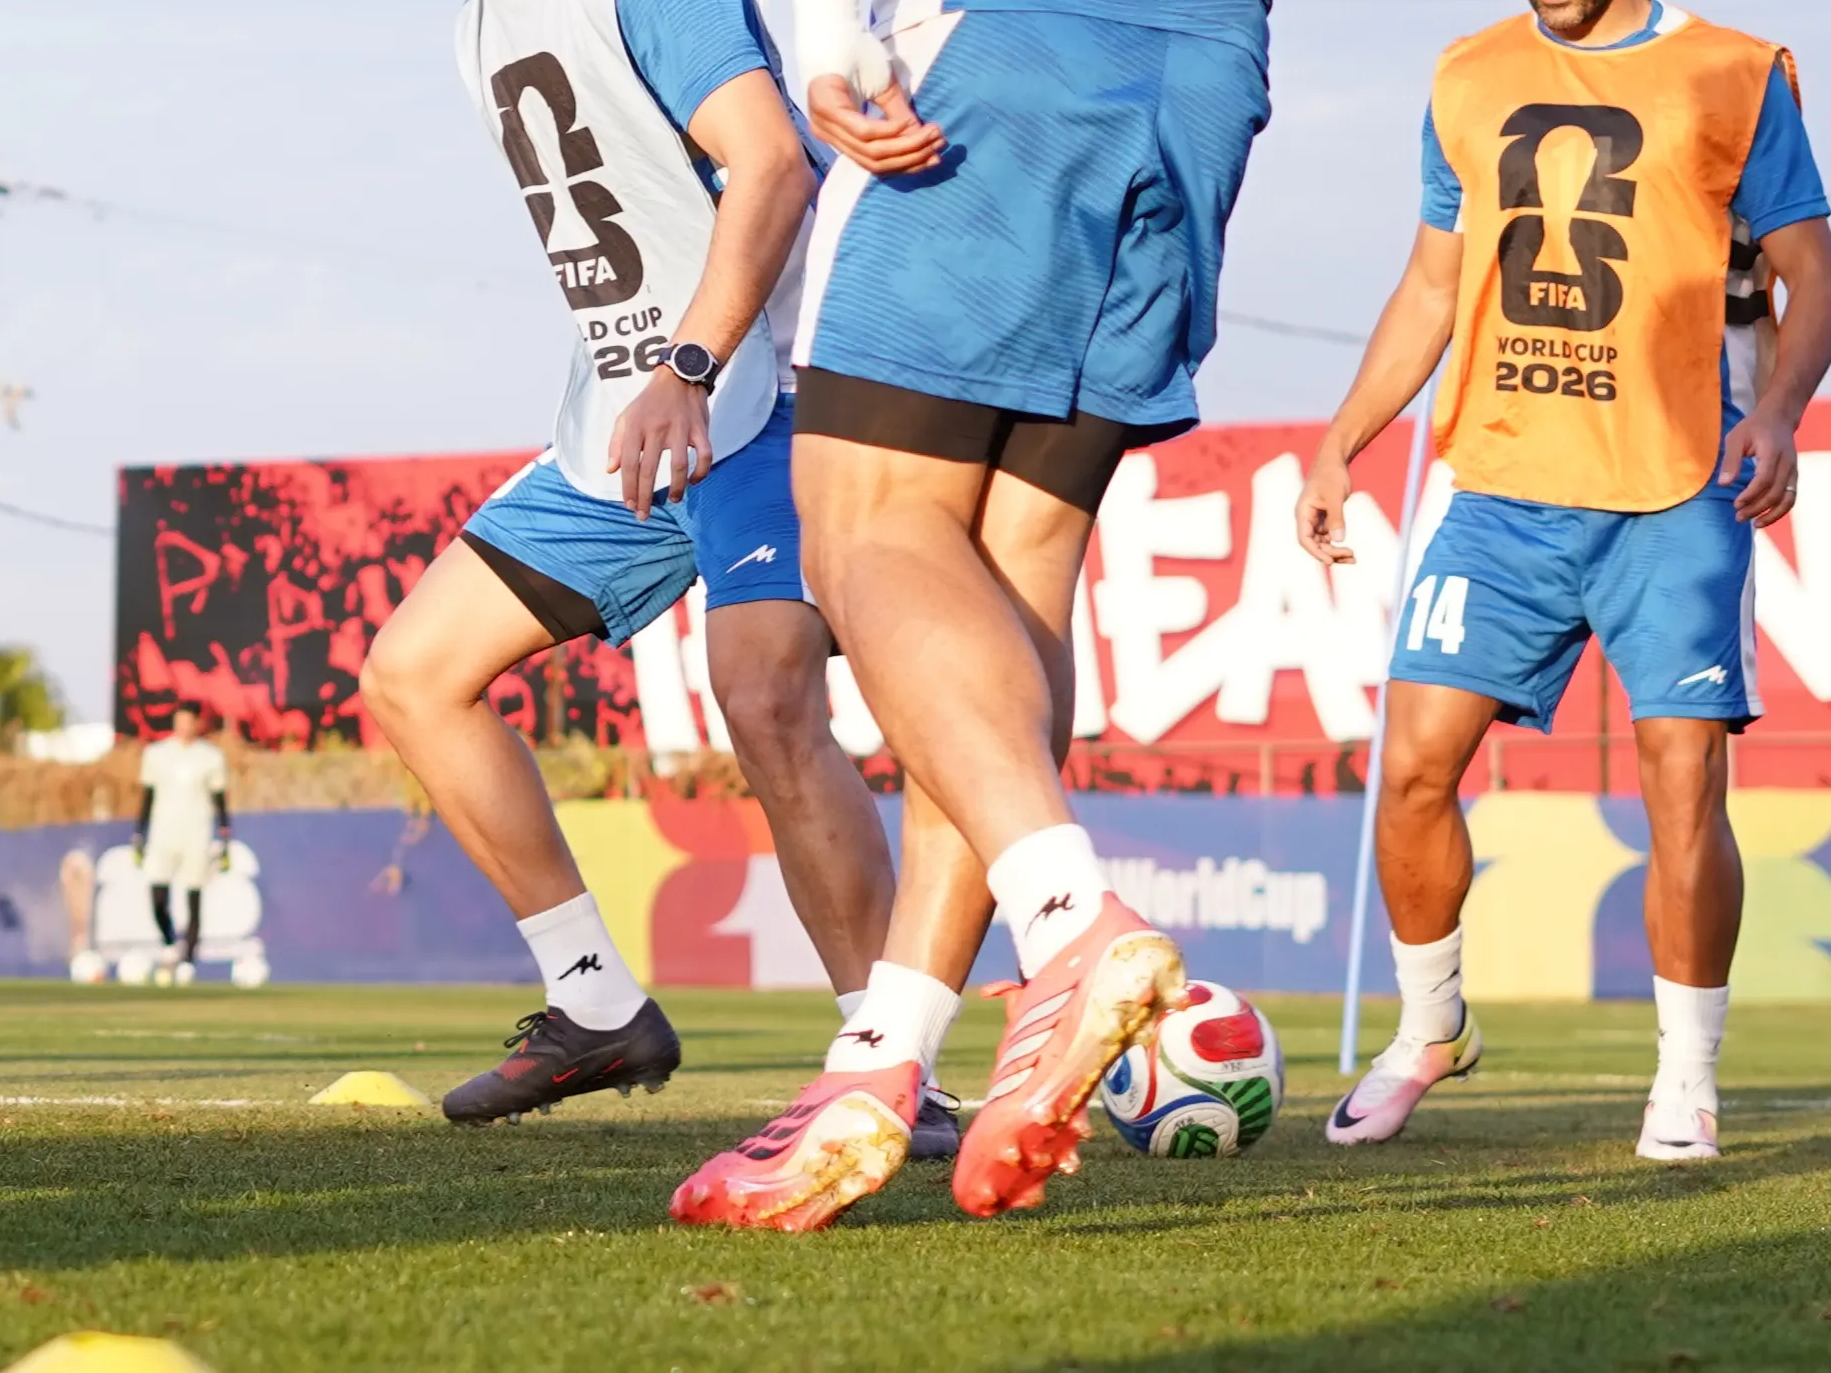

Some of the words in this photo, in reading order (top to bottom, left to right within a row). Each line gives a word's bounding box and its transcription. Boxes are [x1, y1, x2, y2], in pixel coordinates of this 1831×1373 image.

[1529, 281, 1587, 312] FIFA
[615, 306, 663, 337] CUP
[593, 335, 669, 381] 26
[1496, 335, 1572, 359] WORLD
[1575, 343, 1618, 364] CUP
[1495, 361, 1617, 402] 2026
[1406, 575, 1470, 655] 14
[1097, 856, 1328, 944] WorldCup
